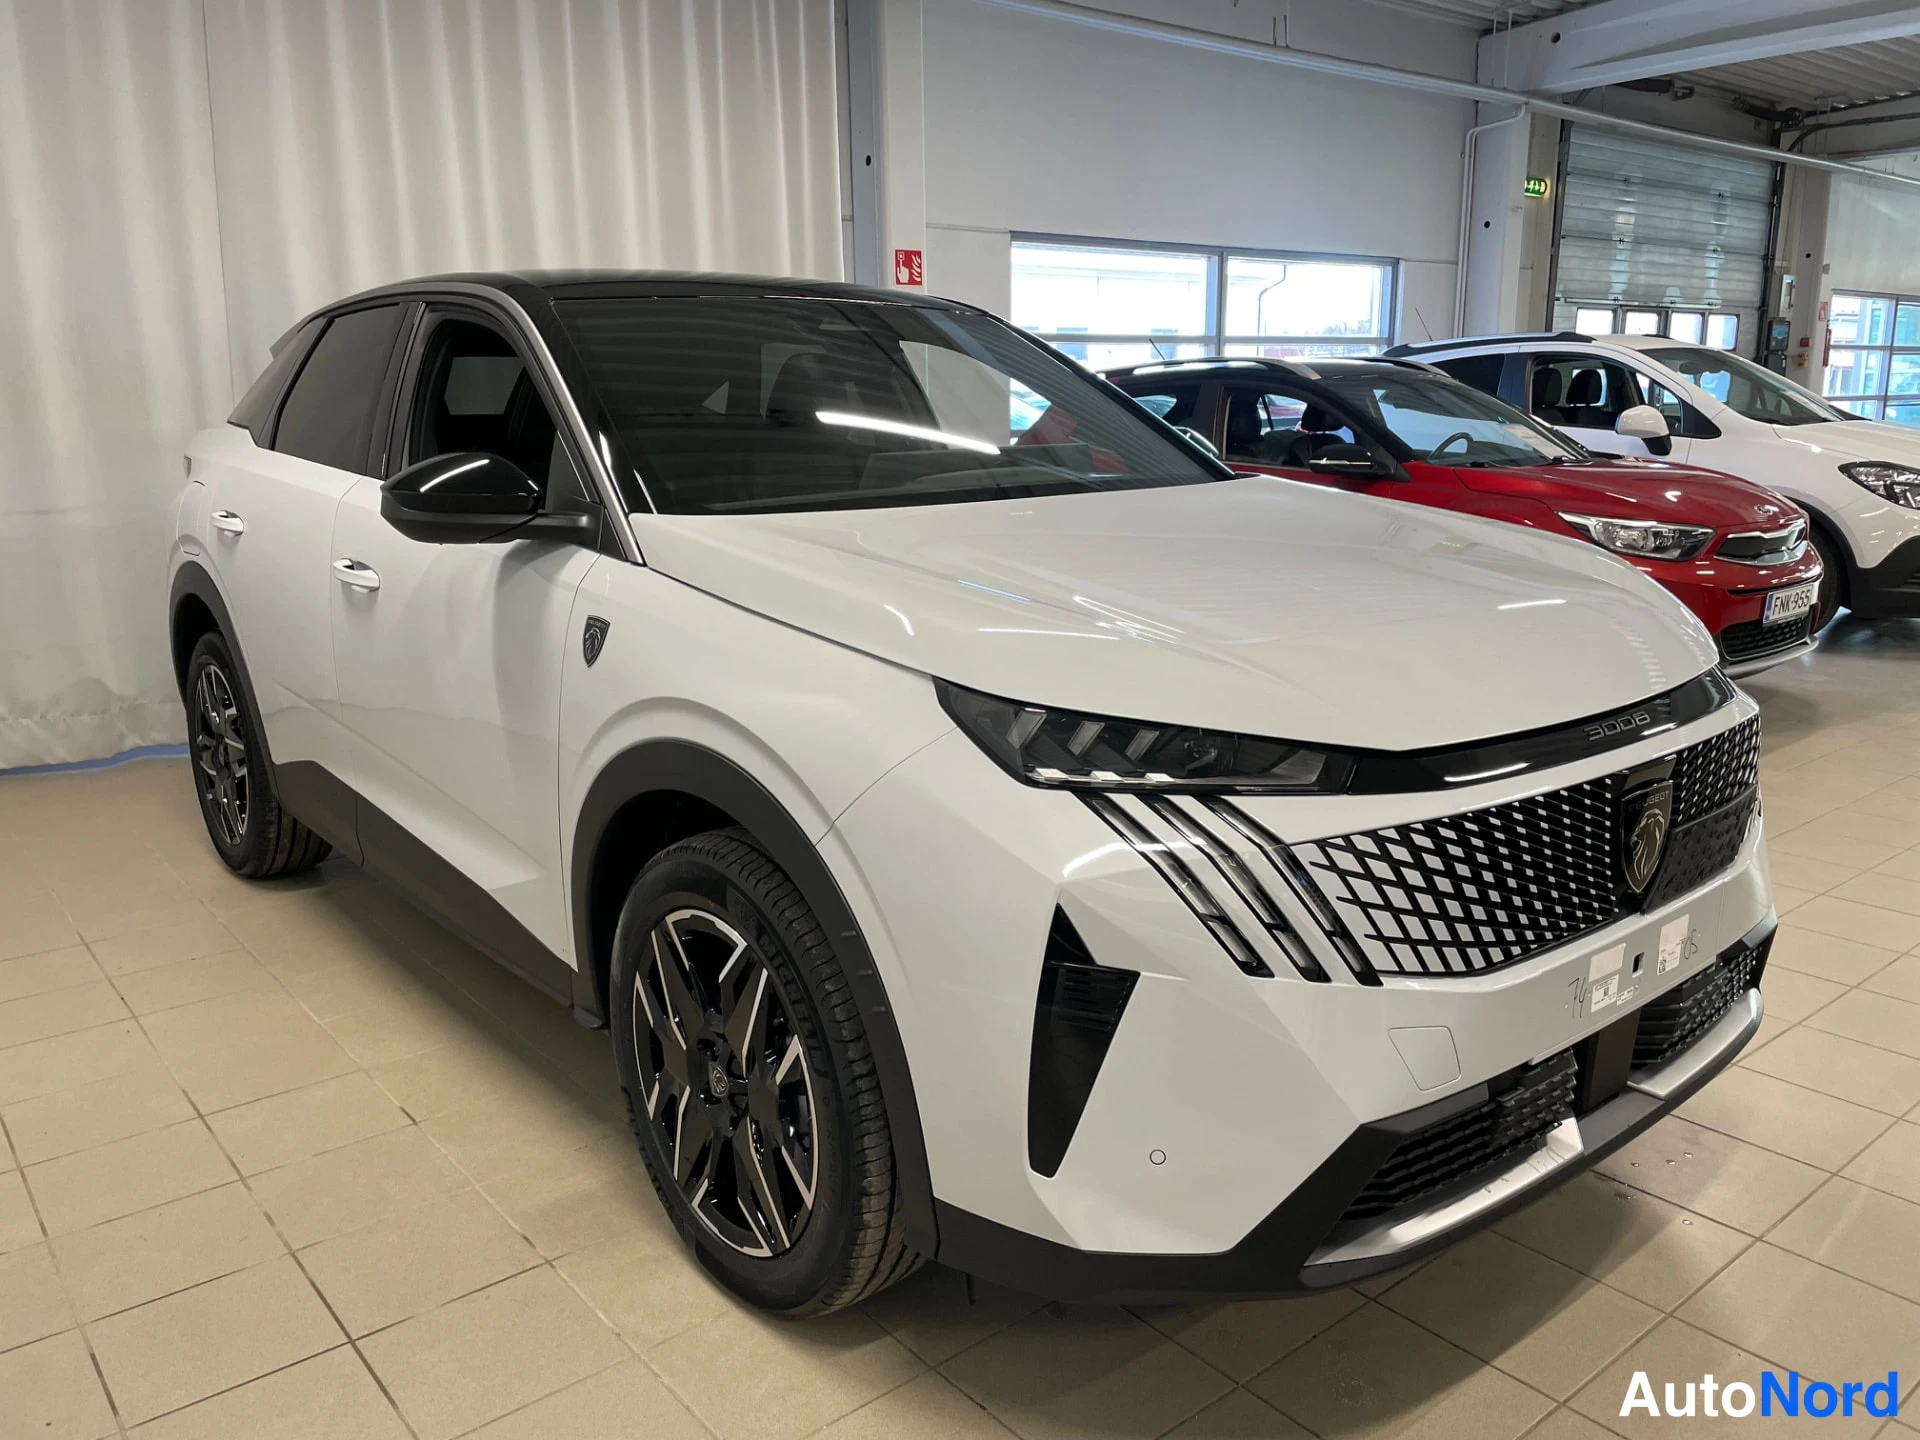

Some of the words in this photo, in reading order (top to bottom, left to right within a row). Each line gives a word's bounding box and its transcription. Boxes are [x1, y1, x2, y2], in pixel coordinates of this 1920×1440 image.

[1772, 589, 1811, 616] FNK-955
[1583, 711, 1651, 741] 3008
[1628, 790, 1670, 813] PEUGEOT
